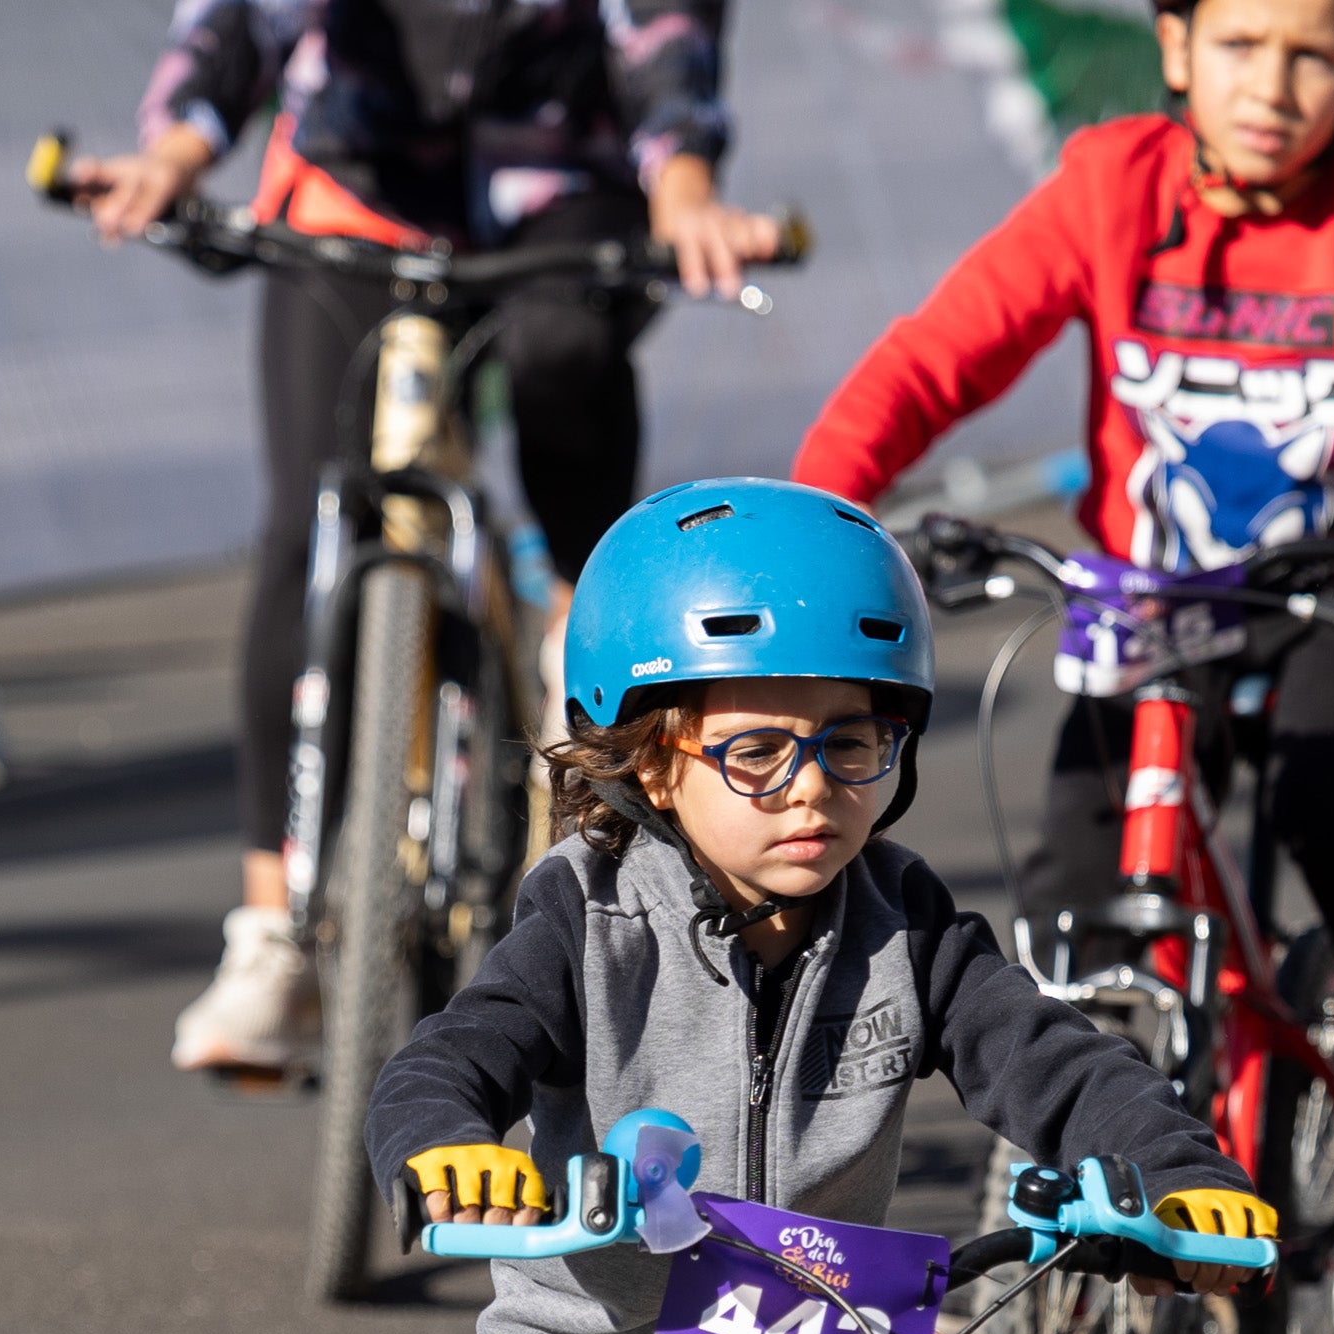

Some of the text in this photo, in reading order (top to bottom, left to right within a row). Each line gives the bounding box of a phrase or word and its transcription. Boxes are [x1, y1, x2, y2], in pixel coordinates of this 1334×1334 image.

[631, 656, 674, 678] oxelo
[807, 1244, 847, 1265] de la
[809, 1261, 851, 1289] Bici
